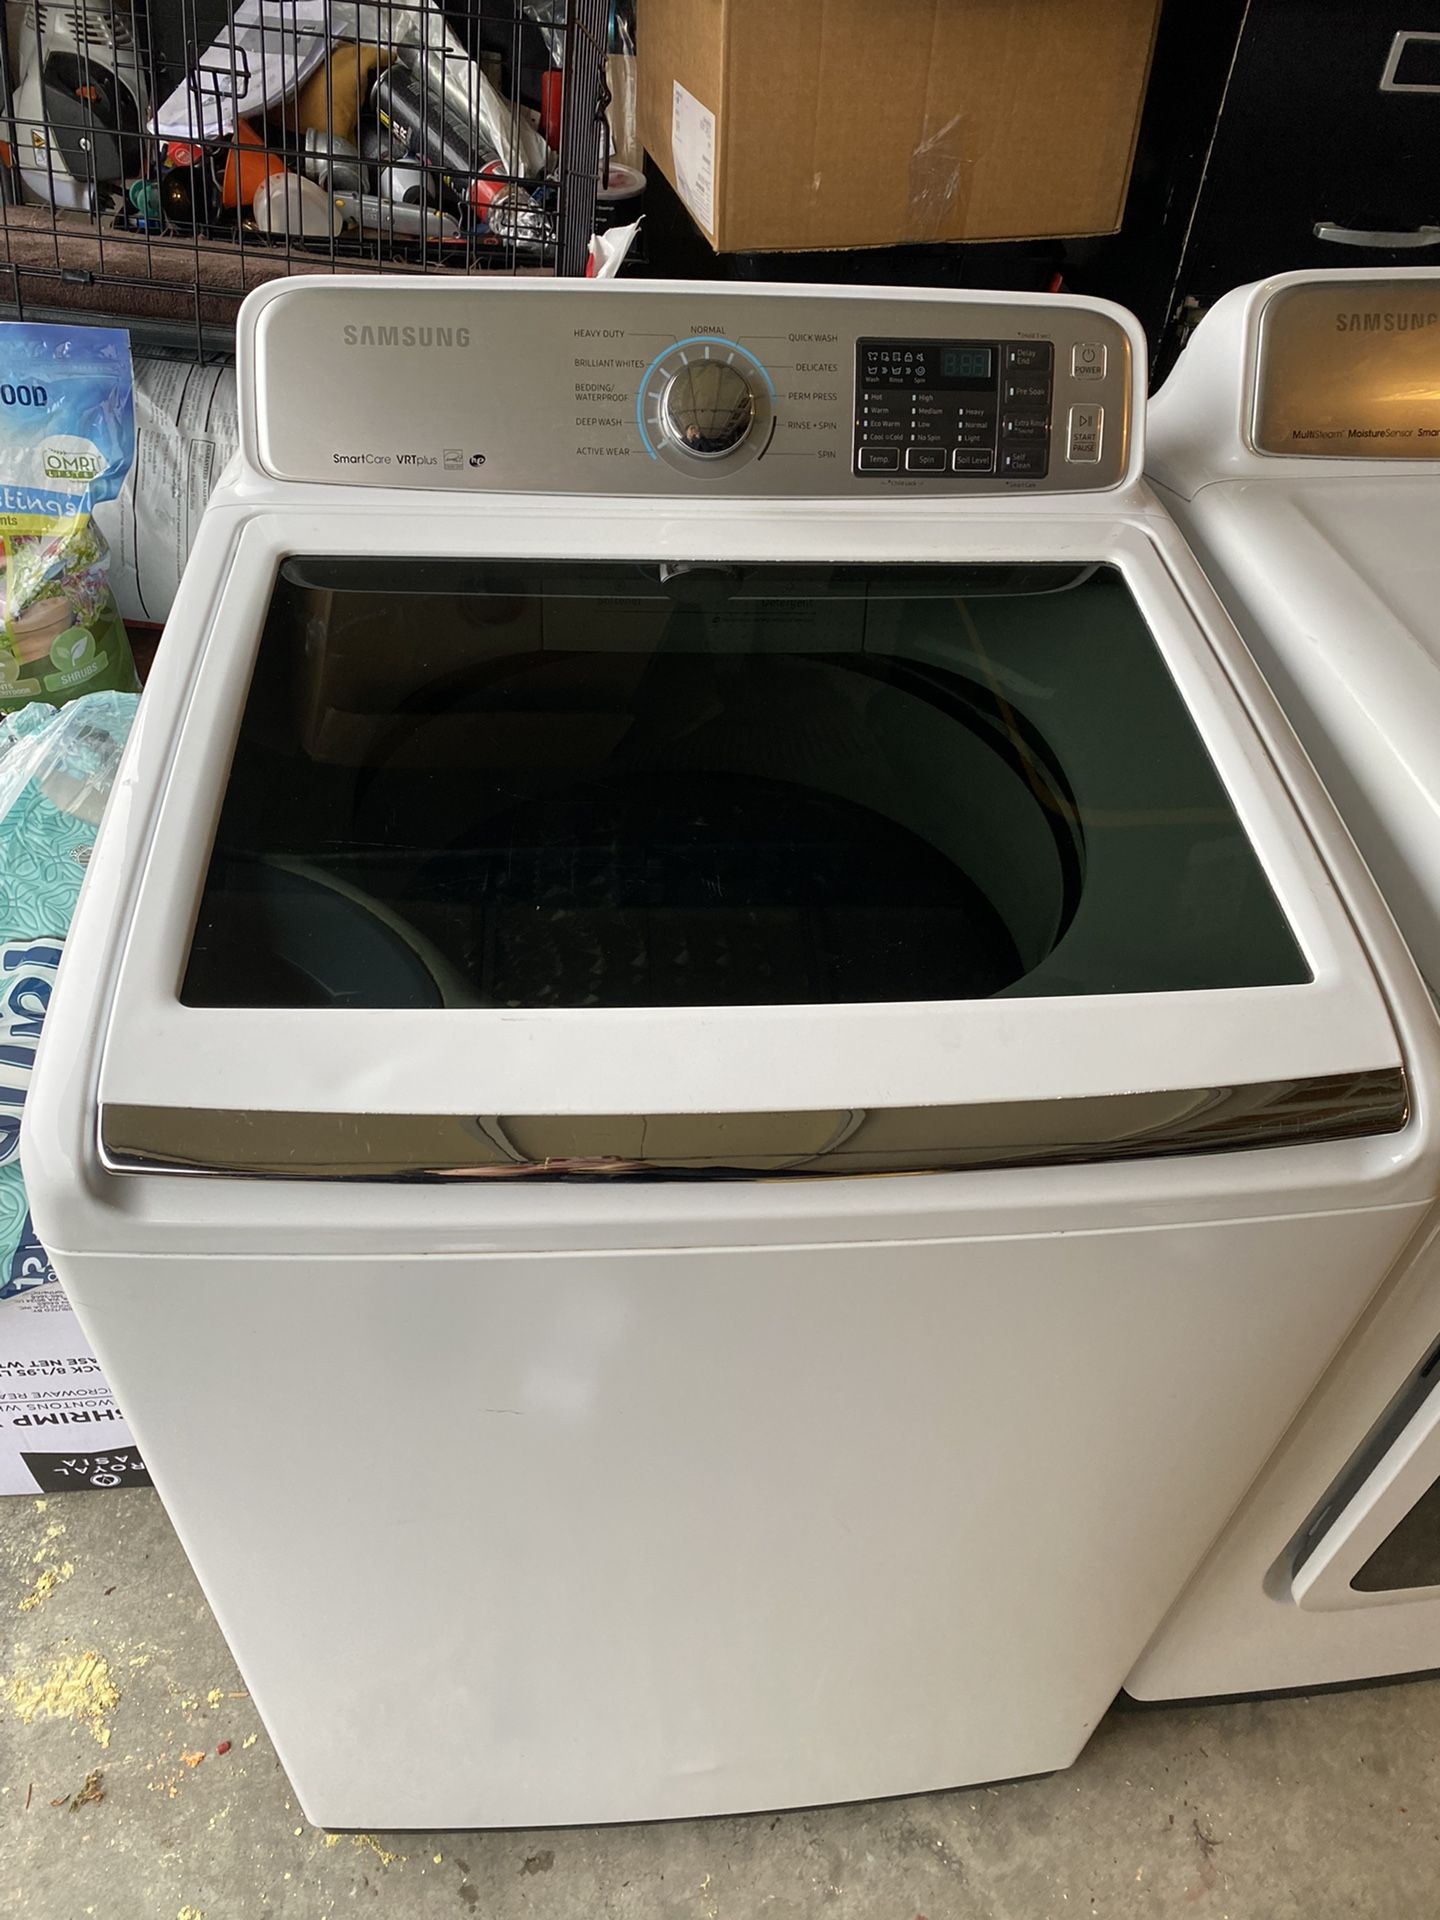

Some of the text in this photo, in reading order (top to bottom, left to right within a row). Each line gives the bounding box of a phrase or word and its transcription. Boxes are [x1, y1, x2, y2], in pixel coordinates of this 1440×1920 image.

[574, 329, 625, 338] HEAVY DUTY
[690, 325, 726, 335] NORMAL
[343, 325, 470, 348] SAMSUNG
[788, 333, 838, 343] QUICK WASH
[1017, 349, 1036, 358] Delay
[574, 358, 645, 368] BRILLIANT WHITES
[795, 363, 838, 372] DELICATES
[1075, 366, 1101, 374] POWER
[575, 383, 615, 393] BEDDING/
[0, 384, 48, 407] OOD
[575, 393, 629, 402] WATERPROOF
[788, 392, 838, 401] PERM PRESS
[965, 408, 984, 416] Heavy
[575, 417, 623, 426] DEEP WASH
[787, 421, 811, 430] RINSE
[818, 422, 837, 430] SPIN
[927, 434, 941, 442] Spin
[1292, 428, 1440, 439] MultiSteam MoistureSensor Smar
[576, 447, 630, 456] ACTIVE WEAR
[817, 450, 836, 459] SPIN
[47, 455, 97, 472] OMRI
[333, 453, 392, 464] SmartCare
[396, 454, 438, 467] VRTplus
[869, 455, 889, 464] Temp.
[919, 456, 935, 464] Spin
[957, 456, 990, 464] Soil Level
[48, 469, 94, 479] LISTE
[0, 488, 77, 518] tings
[0, 515, 18, 526] nts
[60, 662, 98, 685] SHRUBS
[29, 1359, 62, 1368] NET
[67, 1357, 98, 1366] ASE
[16, 1366, 66, 1377] 8/1.95
[31, 1387, 112, 1399] ICROWAVE
[26, 1399, 114, 1411] WONTONS
[62, 1455, 129, 1467] ASIA
[53, 1462, 146, 1476] ROYAL
